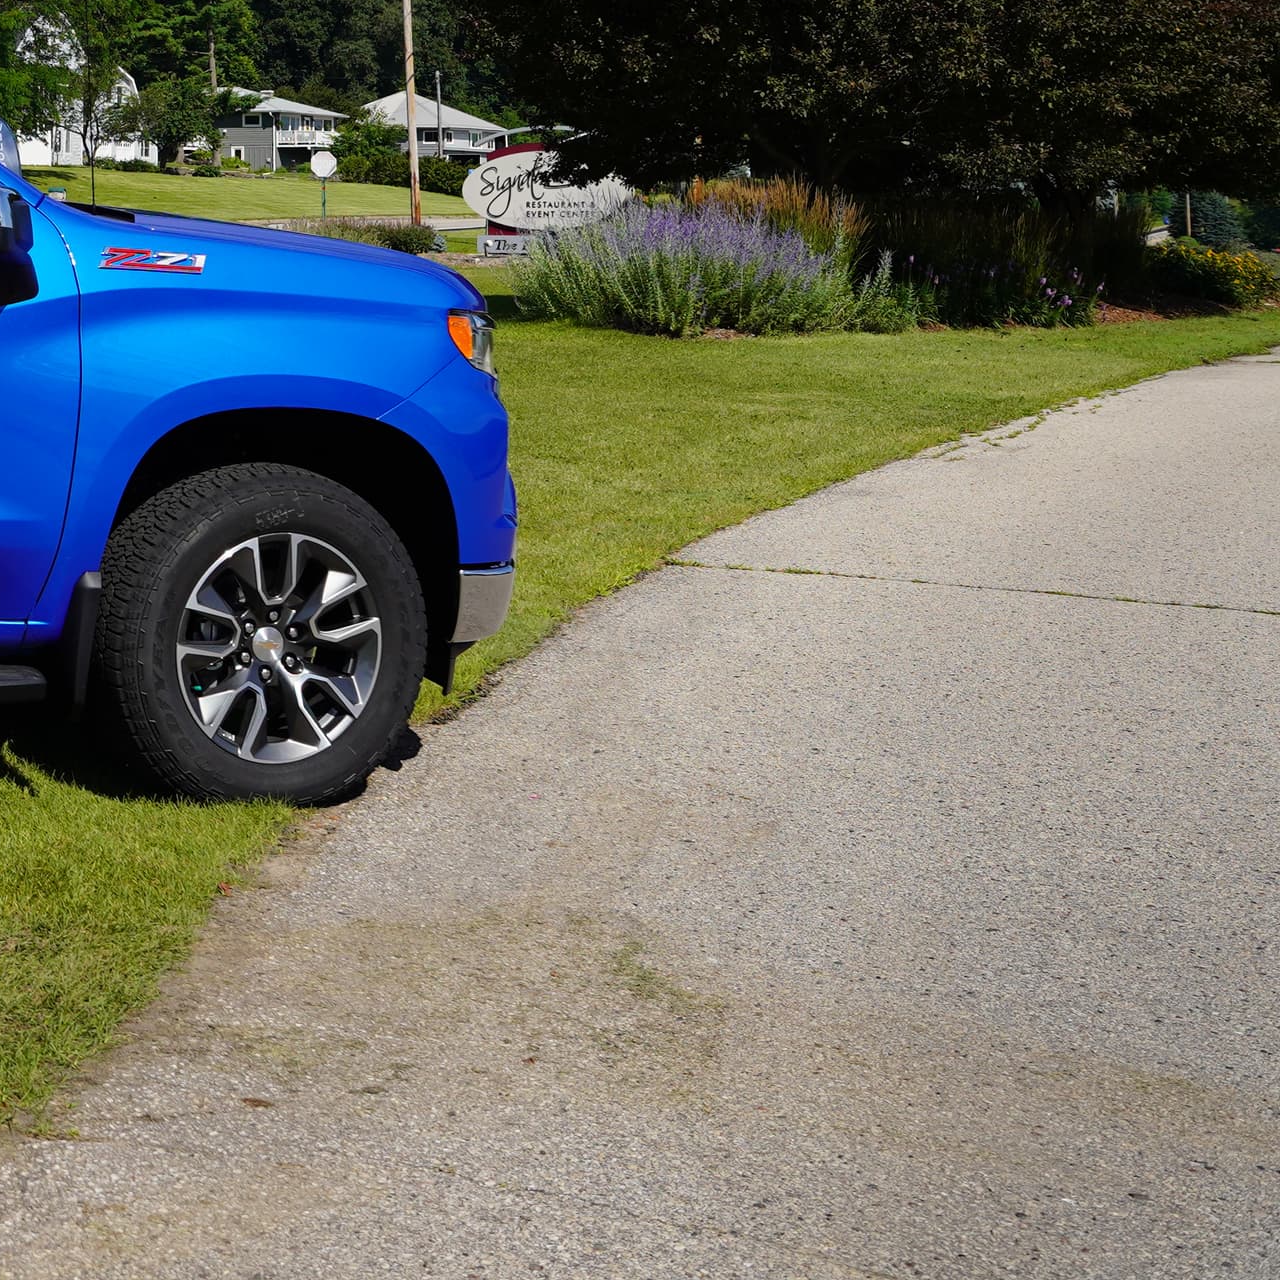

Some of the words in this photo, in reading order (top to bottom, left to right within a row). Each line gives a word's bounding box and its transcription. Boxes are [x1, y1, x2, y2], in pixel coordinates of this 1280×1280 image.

[480, 157, 570, 218] Signat
[525, 201, 585, 209] RESTAURANT
[526, 210, 555, 218] EVENT
[494, 239, 517, 251] The
[98, 246, 207, 275] Z71
